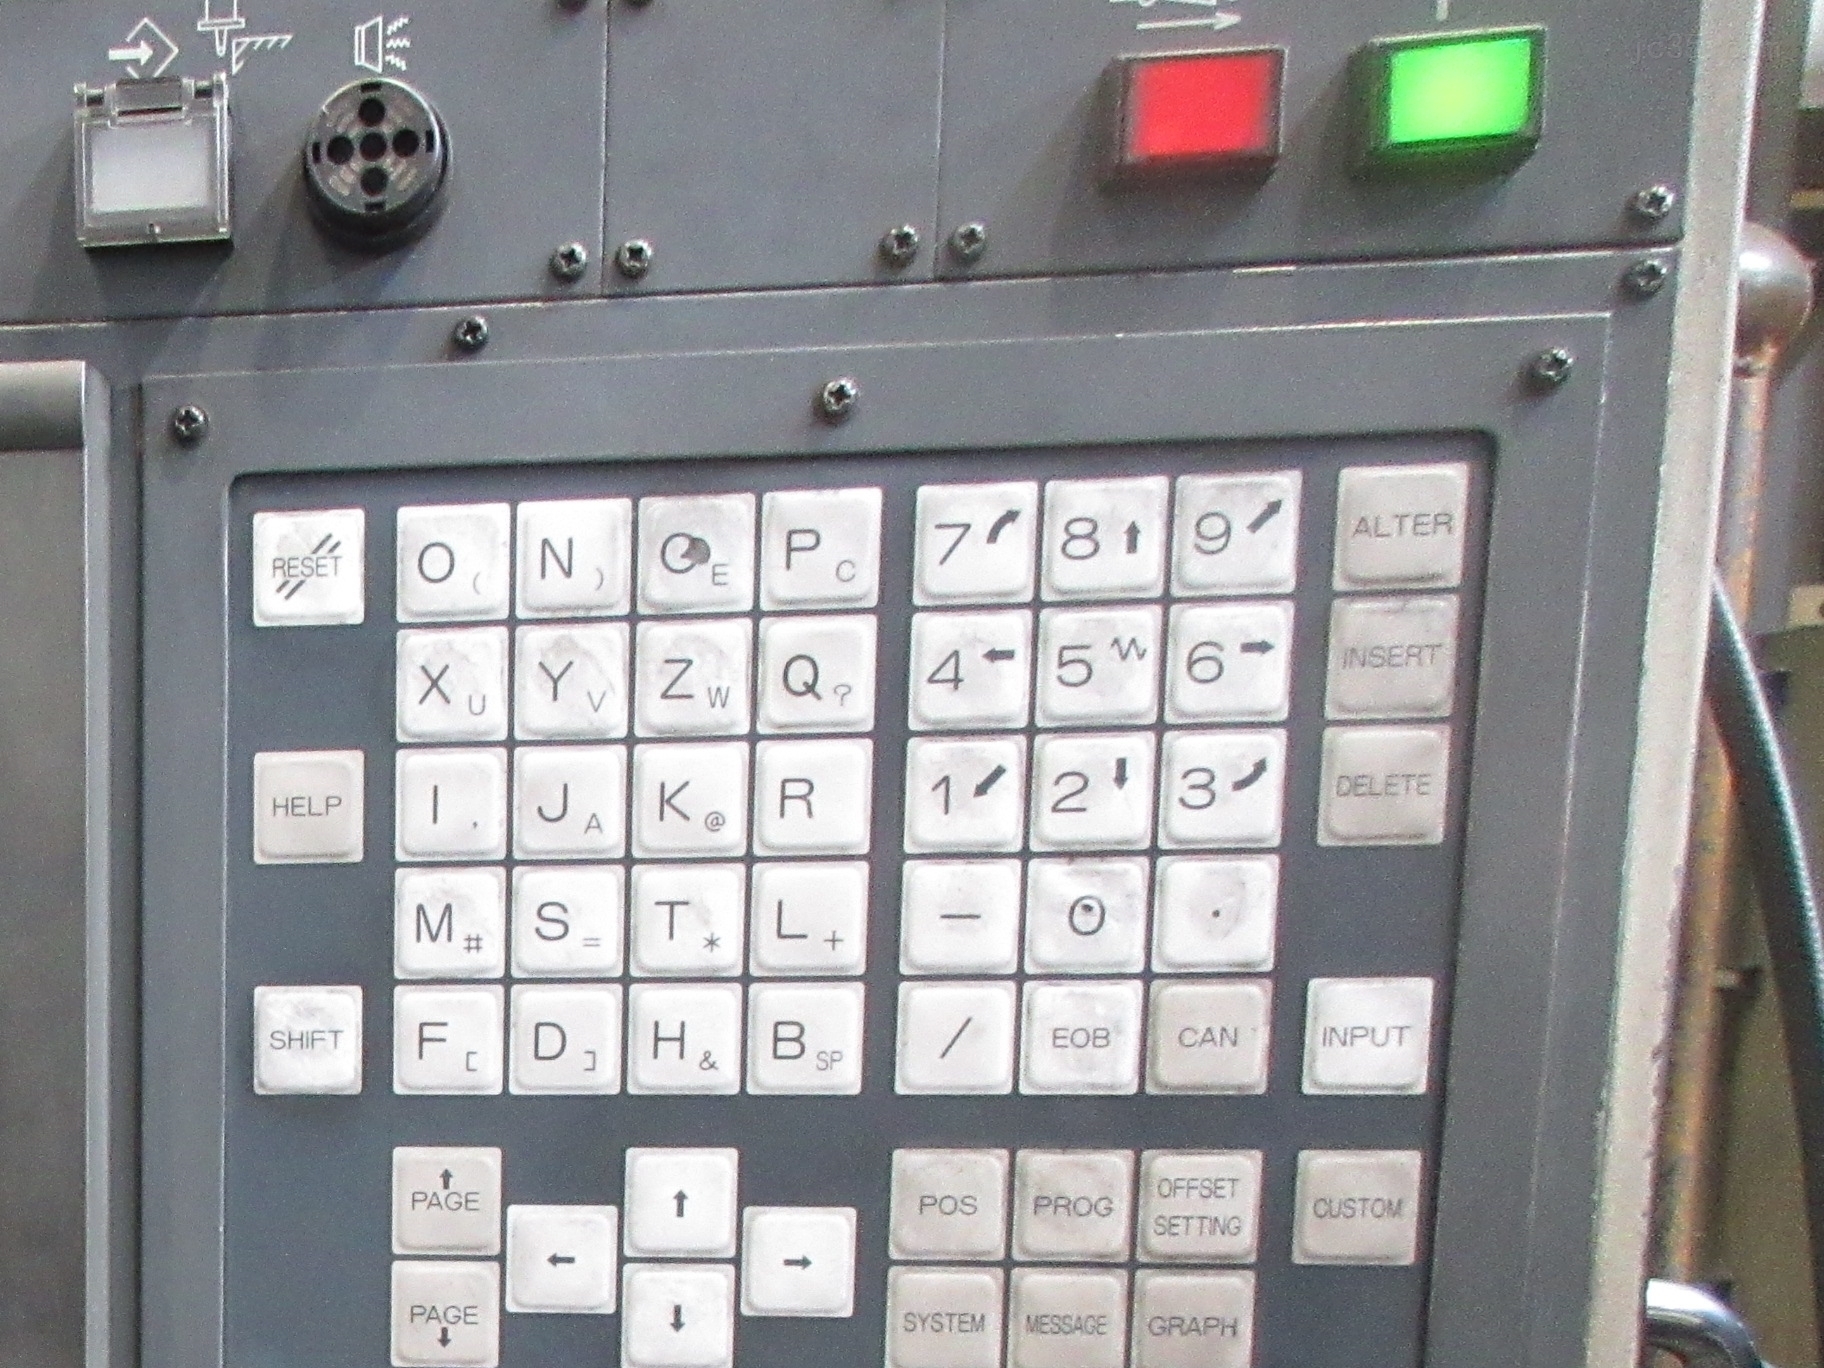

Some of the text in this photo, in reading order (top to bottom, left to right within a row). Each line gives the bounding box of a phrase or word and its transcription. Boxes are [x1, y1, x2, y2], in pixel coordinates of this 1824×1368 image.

[934, 522, 972, 566] 7
[1060, 517, 1100, 561] 8
[1193, 511, 1232, 555] 9
[1351, 512, 1455, 539] ALTER
[271, 555, 343, 579] RESET
[539, 537, 575, 580] N
[711, 562, 730, 587] E
[785, 528, 856, 583] P C
[926, 648, 966, 691] 4
[1056, 643, 1094, 688] 5
[1186, 639, 1225, 685] 6
[1340, 641, 1444, 670] INSERT
[418, 663, 487, 717] X U
[538, 660, 607, 714] Y V
[659, 658, 732, 710] Z W
[782, 653, 823, 702] Q
[658, 779, 691, 823] K
[778, 777, 816, 819] R
[930, 774, 952, 816] 1
[1051, 770, 1090, 814] 2
[1177, 767, 1217, 810] 3
[1335, 773, 1433, 797] DELETE
[271, 795, 344, 818] HELP
[537, 782, 604, 835] J A
[415, 902, 454, 944] M
[534, 901, 570, 942] S
[654, 899, 691, 941] T
[775, 898, 809, 940] L
[268, 1029, 345, 1051] SHIFT
[417, 1020, 450, 1061] F
[533, 1020, 567, 1061] D
[651, 1018, 687, 1060] H
[771, 1018, 844, 1071] B SP
[1051, 1026, 1111, 1050] EOB
[1177, 1026, 1239, 1049] CAN
[1321, 1024, 1412, 1049] INPUT
[411, 1190, 481, 1212] PAGE
[917, 1194, 979, 1216] POS
[1032, 1195, 1114, 1218] PROG
[1156, 1176, 1241, 1198] OFFSET
[1152, 1215, 1242, 1237] SETTING
[1312, 1197, 1403, 1220] CUSTOM
[409, 1304, 480, 1326] PAGE
[902, 1312, 986, 1333] SYSTEM
[1025, 1314, 1108, 1336] MESSAGE
[1146, 1315, 1239, 1338] GRAPH
